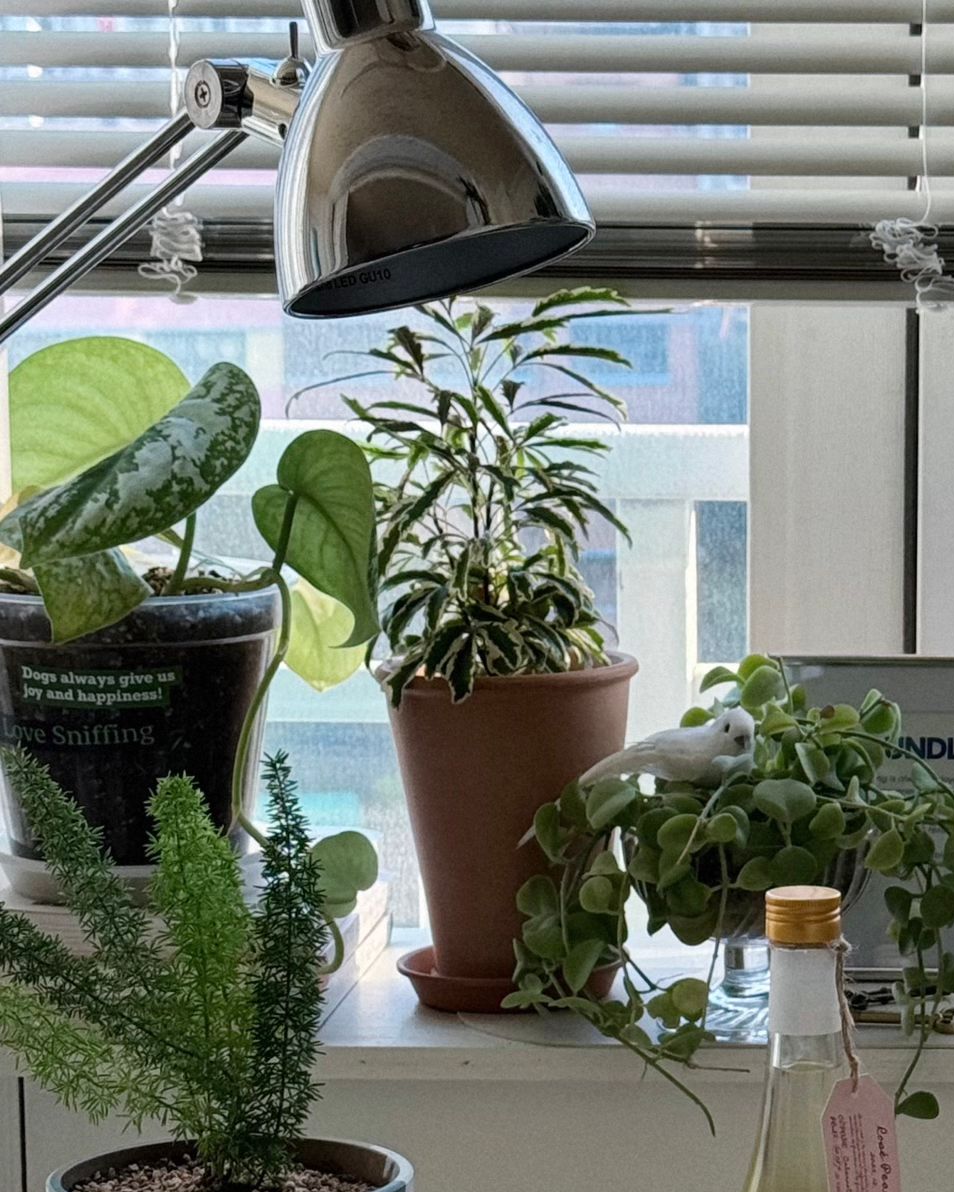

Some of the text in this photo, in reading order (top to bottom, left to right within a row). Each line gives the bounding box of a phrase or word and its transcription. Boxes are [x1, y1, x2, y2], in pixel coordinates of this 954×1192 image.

[333, 275, 357, 288] LED
[359, 268, 392, 284] GU10
[21, 666, 175, 687] Dogs always give us
[23, 684, 163, 706] joy and happiness!
[52, 723, 155, 746] Sniffing
